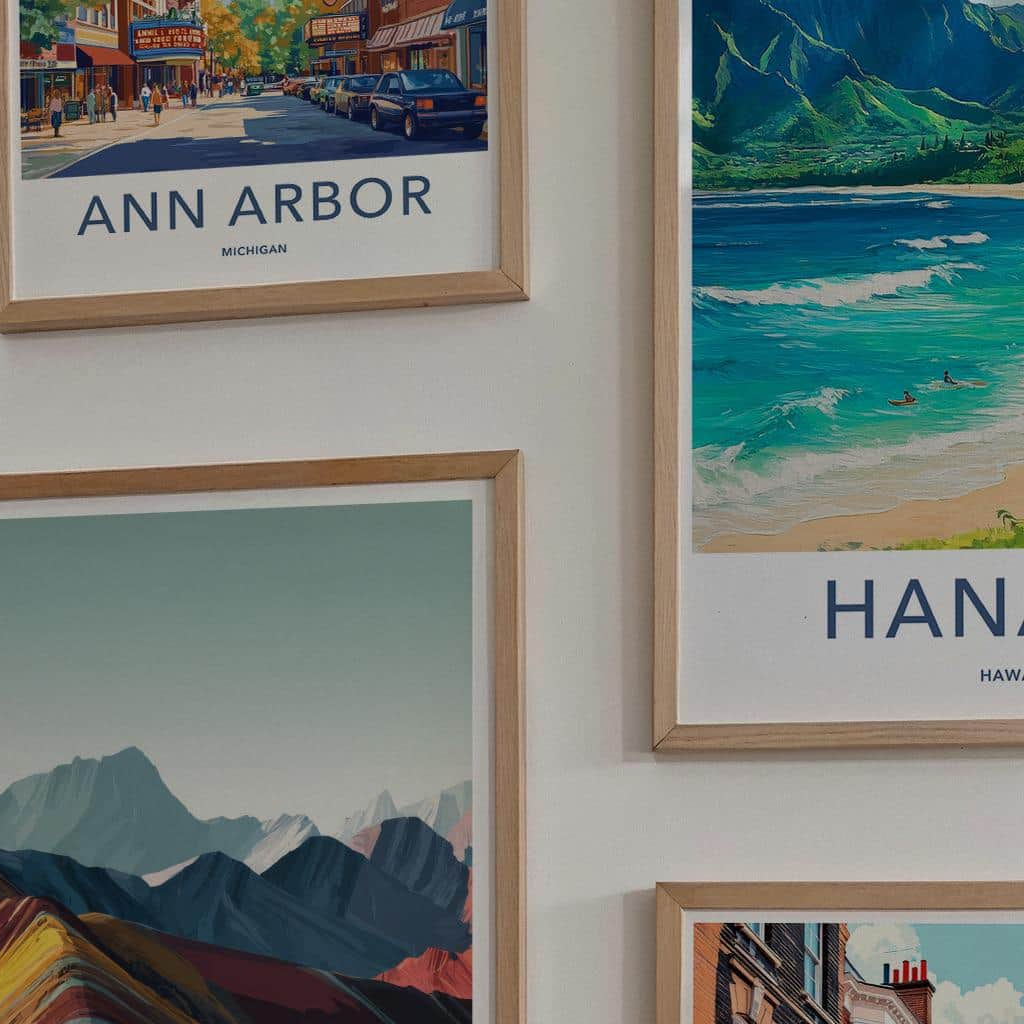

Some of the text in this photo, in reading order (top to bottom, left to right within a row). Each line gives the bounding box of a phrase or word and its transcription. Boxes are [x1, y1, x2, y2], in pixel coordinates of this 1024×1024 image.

[77, 175, 432, 236] ANN ARBOR
[221, 243, 288, 257] MICHIGAN
[827, 577, 1024, 639] HAN
[980, 668, 1024, 682] HAW
